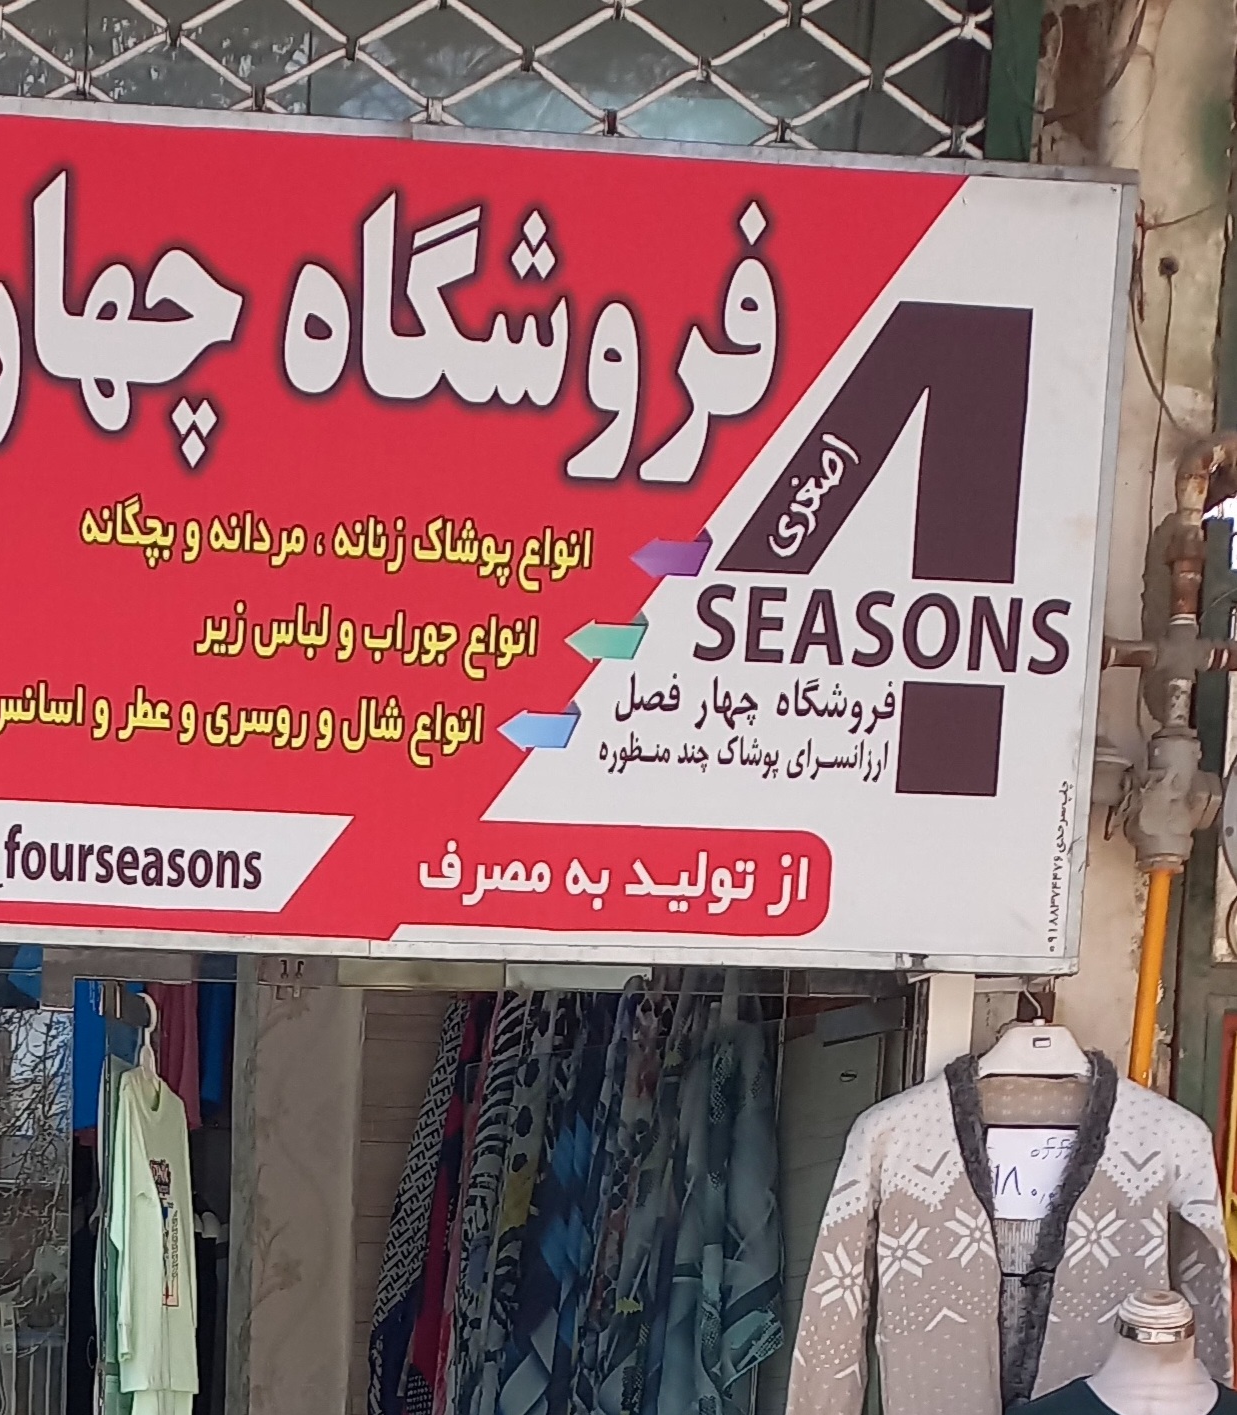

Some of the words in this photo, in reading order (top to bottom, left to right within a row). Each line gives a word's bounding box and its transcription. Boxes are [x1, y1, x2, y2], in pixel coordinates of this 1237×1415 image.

[283, 189, 779, 484] فروشگاه
[79, 492, 177, 570] بچگانه
[181, 517, 203, 563] و
[209, 509, 307, 568] مردانه
[332, 514, 407, 573] زنانه
[413, 514, 513, 588] پوشاک
[517, 525, 594, 593] انواع
[193, 598, 248, 657] زیر
[252, 601, 332, 660] لباس
[335, 616, 356, 662] و
[361, 608, 460, 666] جوراب
[461, 613, 540, 681] انواع
[692, 583, 1072, 676] SEASONS
[91, 694, 111, 741] و
[115, 683, 173, 742] عطر
[177, 701, 199, 746] و
[202, 697, 310, 751] روسری
[339, 694, 405, 752] شال
[614, 672, 681, 723] فصل
[693, 675, 759, 730] چهار
[775, 678, 896, 736] فروشگاه
[314, 706, 335, 751] و
[407, 700, 484, 768] انواع
[598, 737, 672, 776] منظوره
[716, 735, 780, 778] پوشاک
[676, 742, 710, 774] چند
[785, 737, 890, 784] ارزانسرای
[418, 839, 552, 907] مصرف
[564, 857, 612, 912] به
[624, 850, 757, 917] تولید
[766, 853, 810, 917] از
